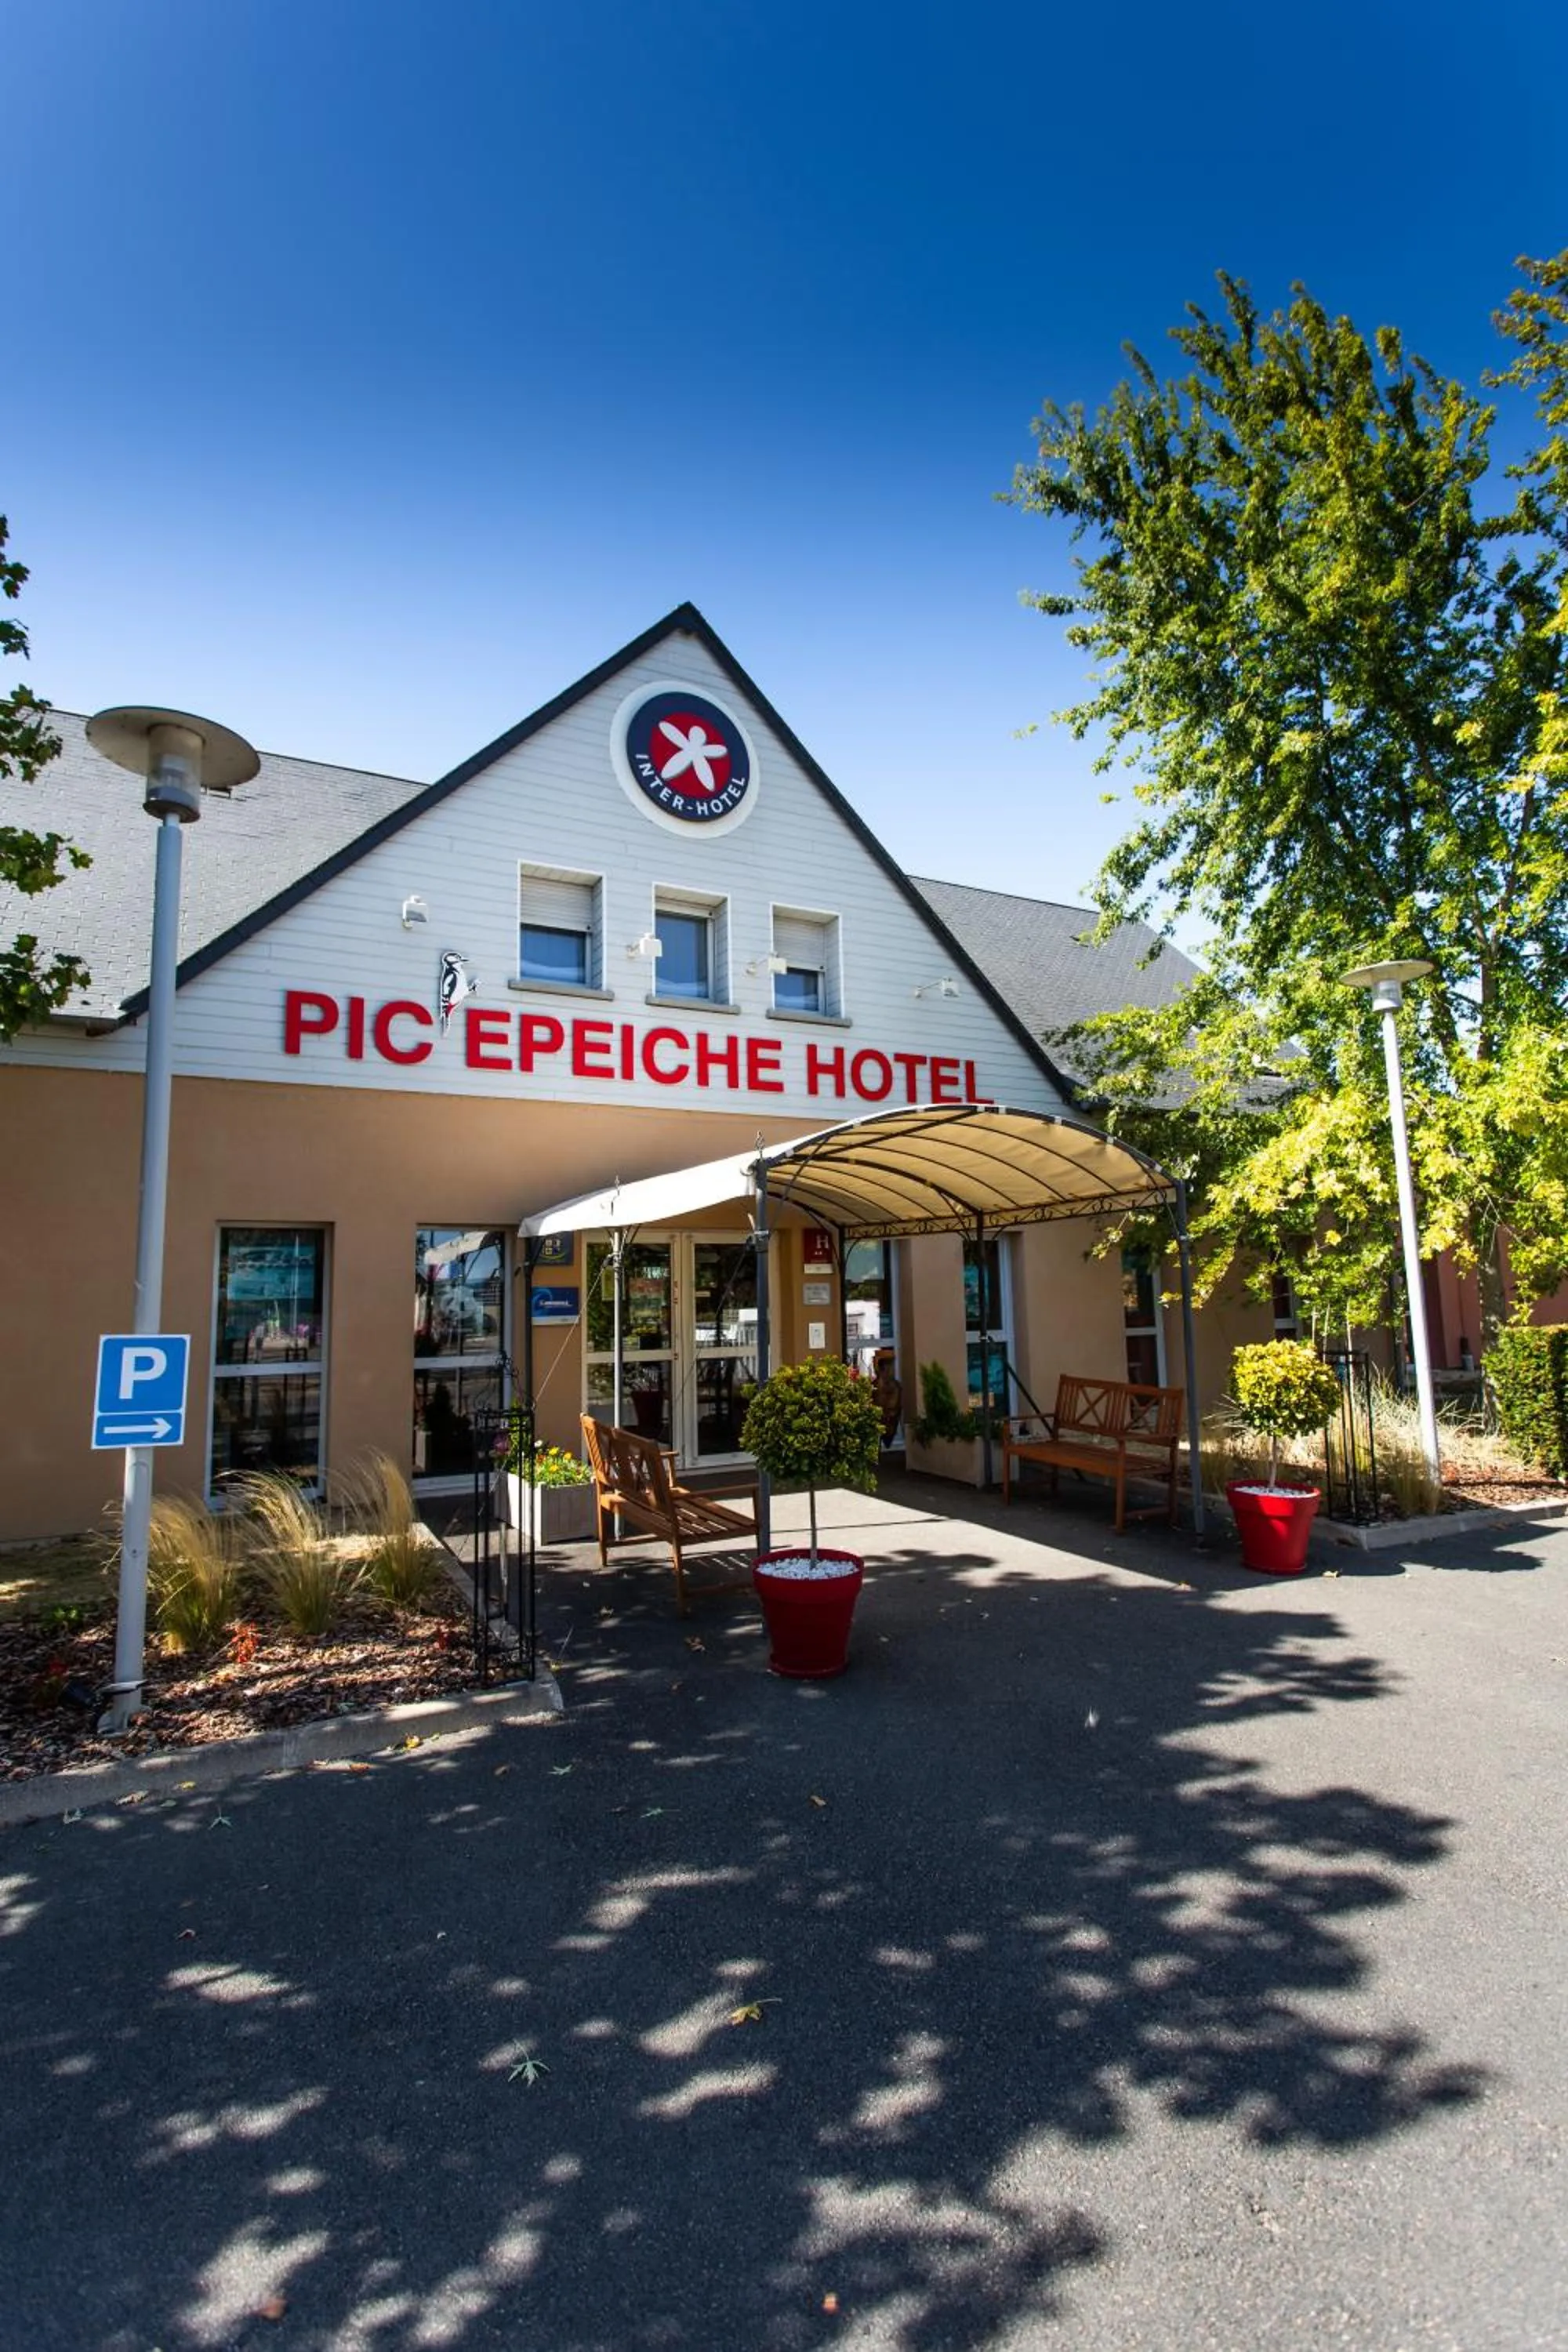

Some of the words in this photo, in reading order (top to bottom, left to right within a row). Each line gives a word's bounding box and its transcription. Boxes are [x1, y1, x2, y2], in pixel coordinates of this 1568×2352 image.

[635, 753, 746, 816] INTER-HOTEL
[285, 990, 433, 1065] PIC
[466, 1009, 784, 1094] EPEICHE
[807, 1044, 994, 1104] HOTEL
[119, 1346, 167, 1399] P
